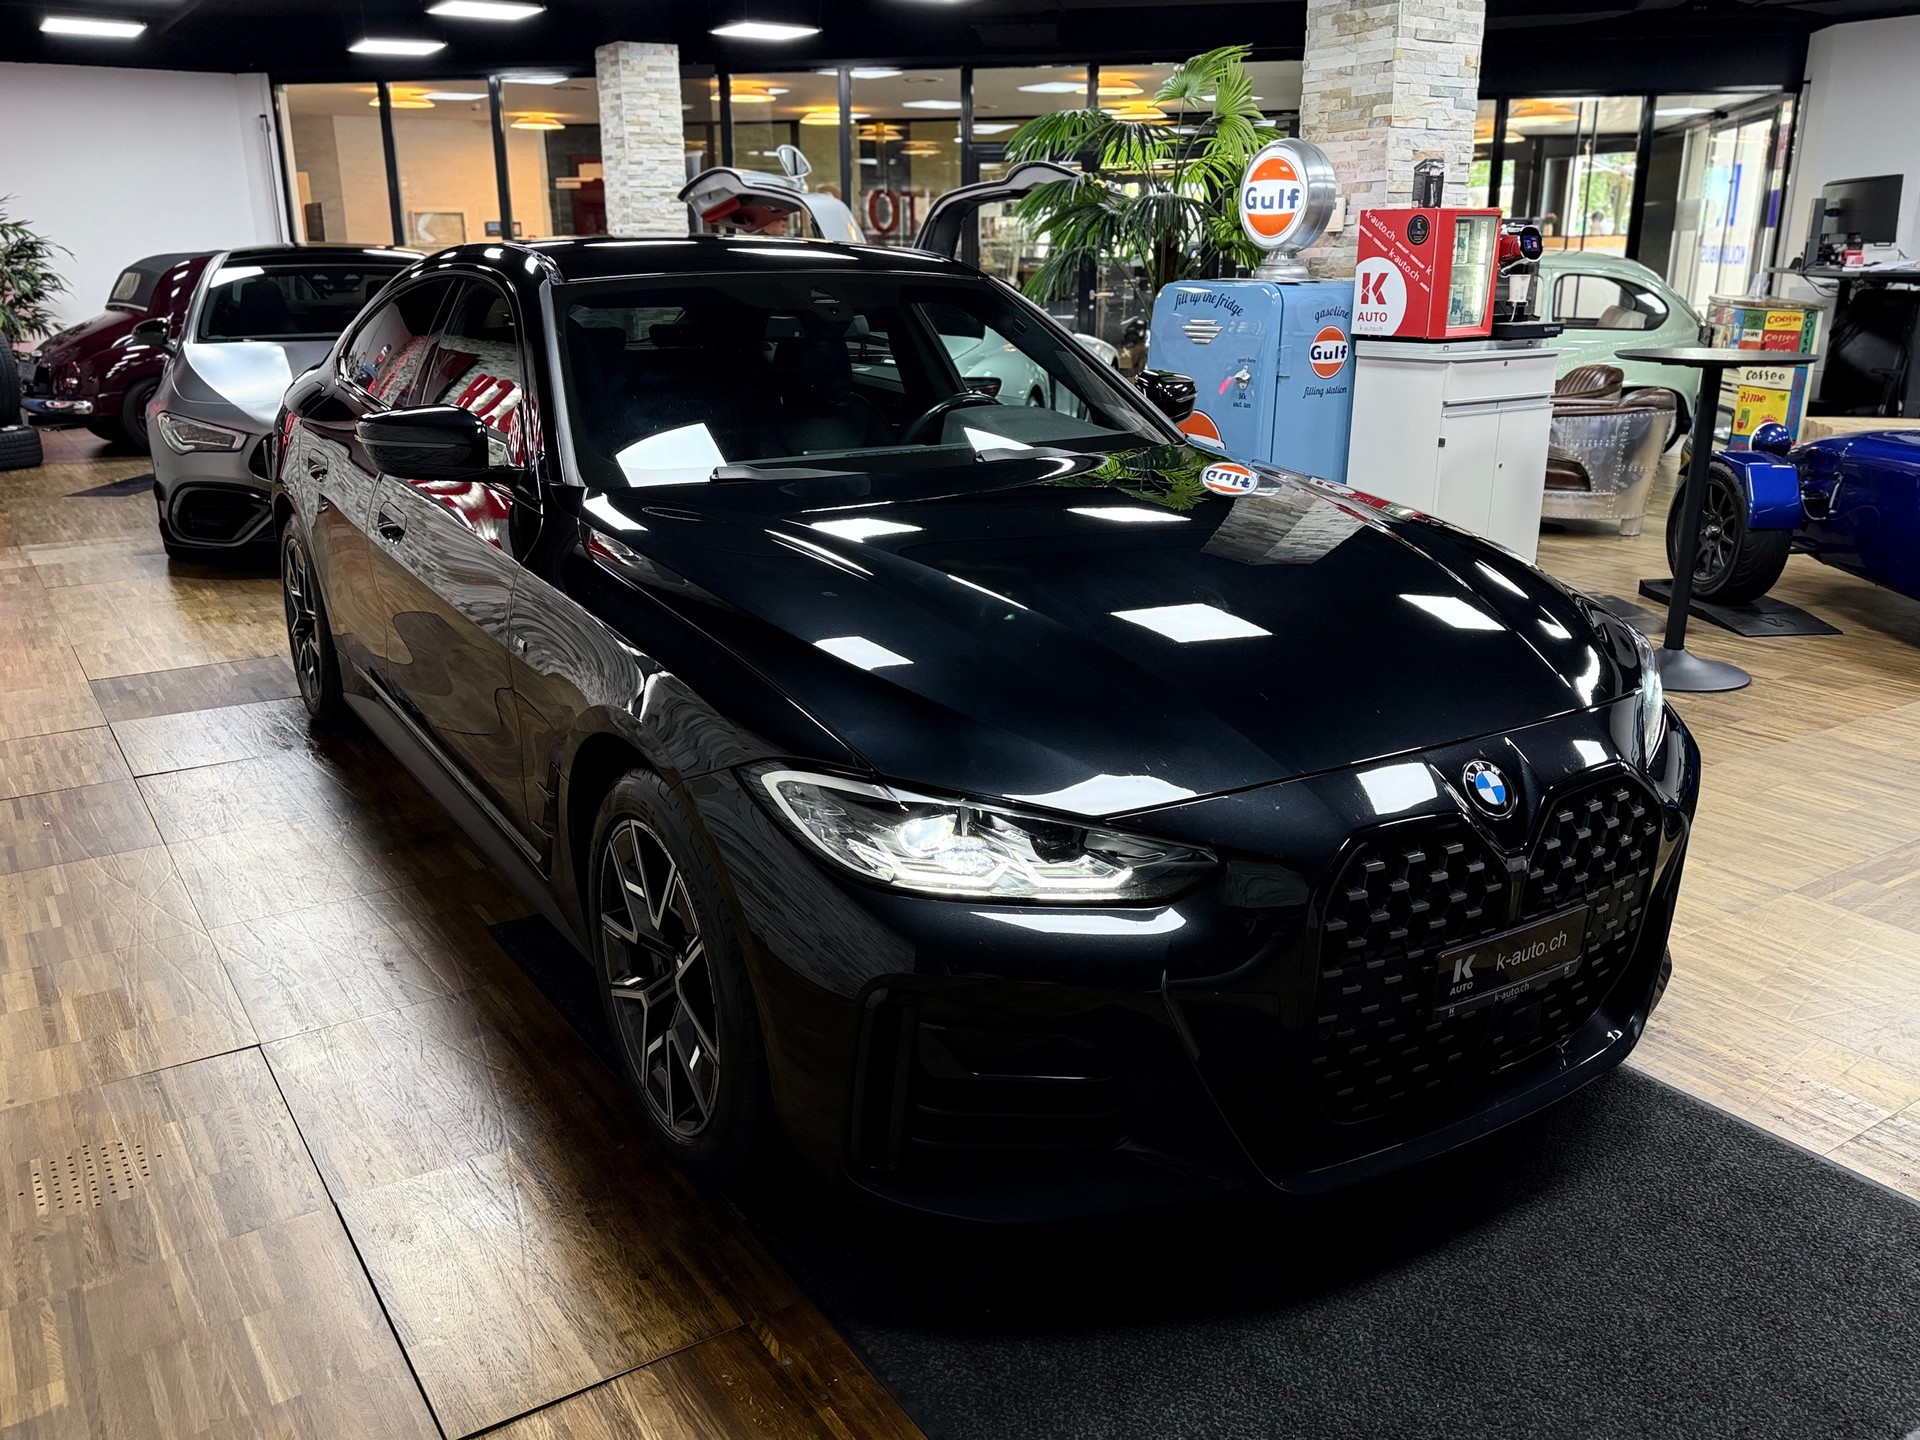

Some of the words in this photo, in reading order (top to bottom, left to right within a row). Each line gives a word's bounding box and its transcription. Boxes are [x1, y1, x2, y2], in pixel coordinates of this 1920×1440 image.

[1245, 186, 1300, 209] Gulf
[1365, 209, 1395, 241] k-auto.ch
[1389, 247, 1420, 281] k-auto.ch
[1361, 272, 1389, 305] K
[1174, 293, 1188, 311] fill
[1190, 293, 1201, 306] up
[1203, 292, 1217, 304] the
[1214, 293, 1244, 316] fridge
[1314, 306, 1350, 323] gasoline
[1357, 311, 1388, 322] AUTO
[1310, 344, 1348, 360] Gulf
[1302, 386, 1324, 399] filling
[1325, 385, 1348, 395] station
[1466, 762, 1501, 783] BMW
[1453, 953, 1477, 983] K
[1495, 930, 1568, 972] k-auto.ch
[1449, 981, 1474, 996] AUTO
[1494, 981, 1530, 1002] k-auto.ch
